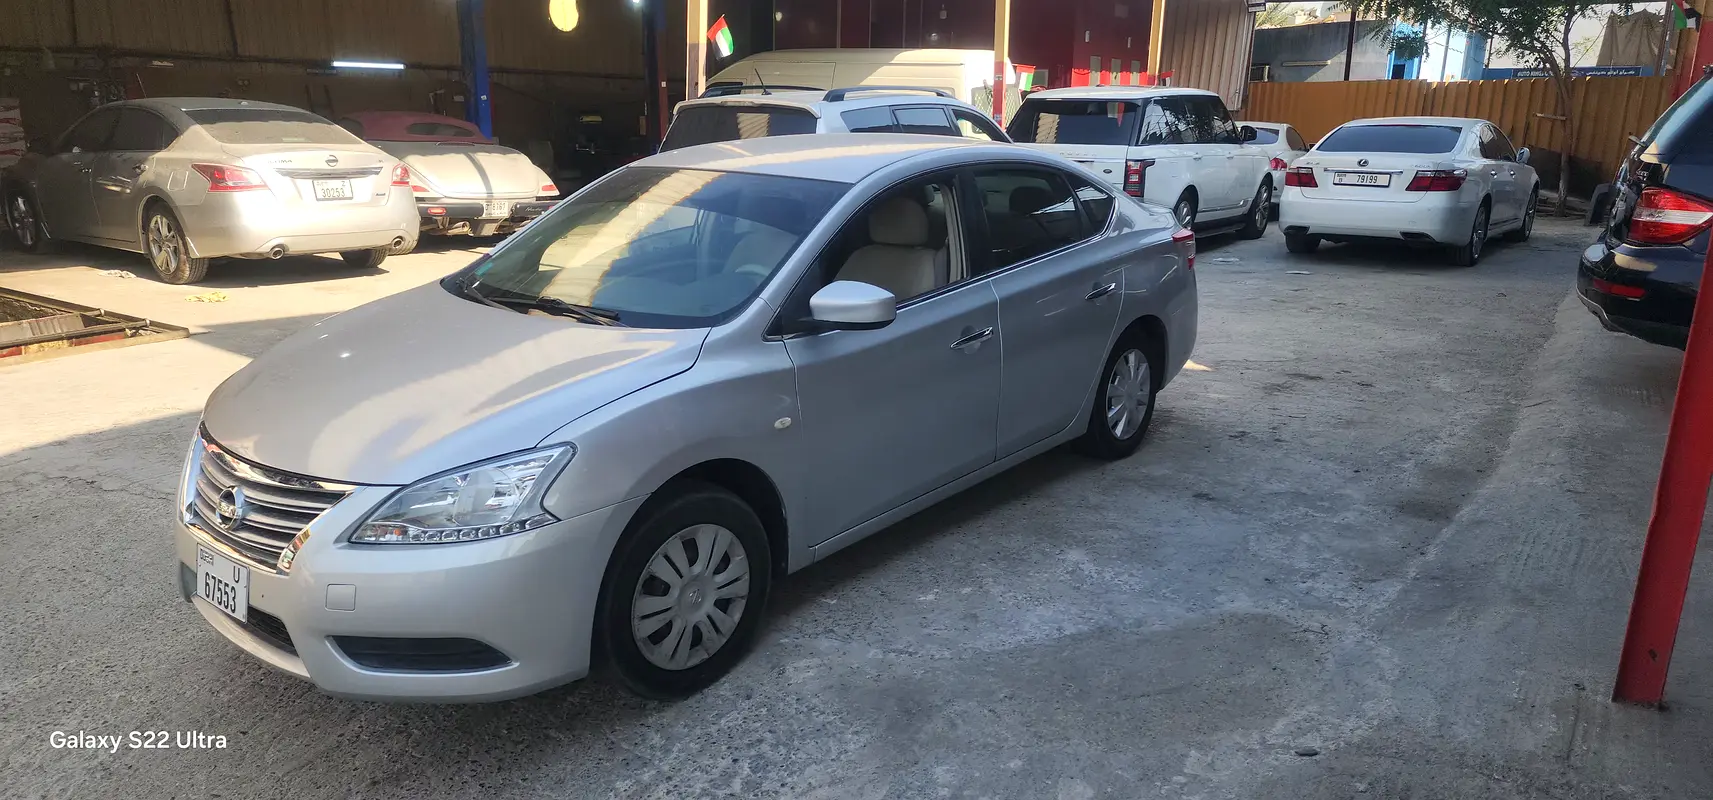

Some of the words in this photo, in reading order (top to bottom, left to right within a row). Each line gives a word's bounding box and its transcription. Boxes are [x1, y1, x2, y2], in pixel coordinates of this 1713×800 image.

[1356, 174, 1378, 184] 79199
[321, 187, 346, 198] 30253
[233, 565, 241, 584] U
[204, 571, 237, 614] 67553
